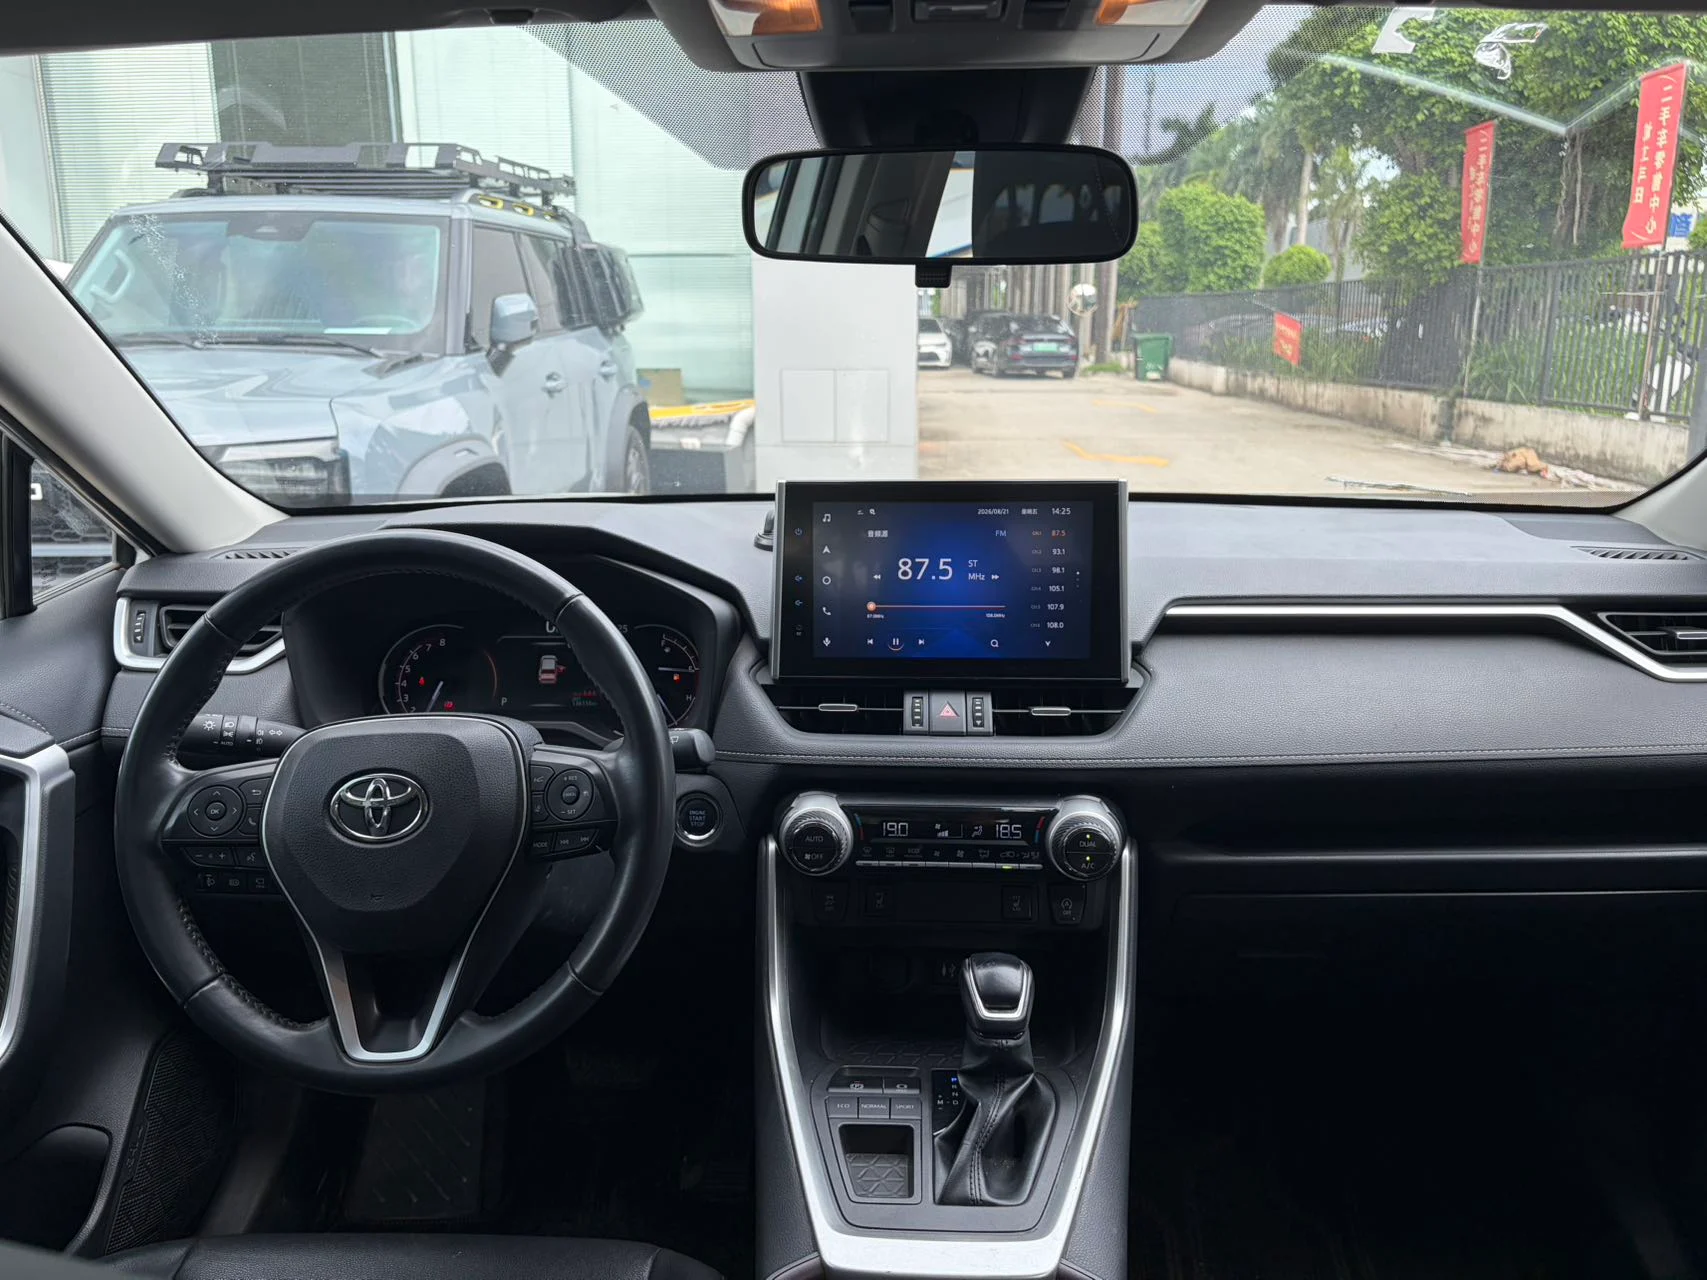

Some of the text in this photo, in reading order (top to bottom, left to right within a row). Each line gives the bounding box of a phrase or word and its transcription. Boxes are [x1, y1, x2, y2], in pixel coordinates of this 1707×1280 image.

[1051, 507, 1071, 515] 14:25
[995, 529, 1007, 537] FM
[1051, 529, 1066, 537] 87.5
[968, 559, 979, 568] ST
[897, 558, 953, 581] 87.5
[1051, 566, 1065, 574] 98.1
[1046, 621, 1065, 629] 108.0
[440, 638, 446, 646] 8
[405, 665, 411, 673] 5
[404, 694, 409, 702] 3
[501, 697, 507, 706] P
[995, 824, 1022, 839] 18.5
[805, 835, 824, 843] AUTO
[533, 841, 548, 849] MODE
